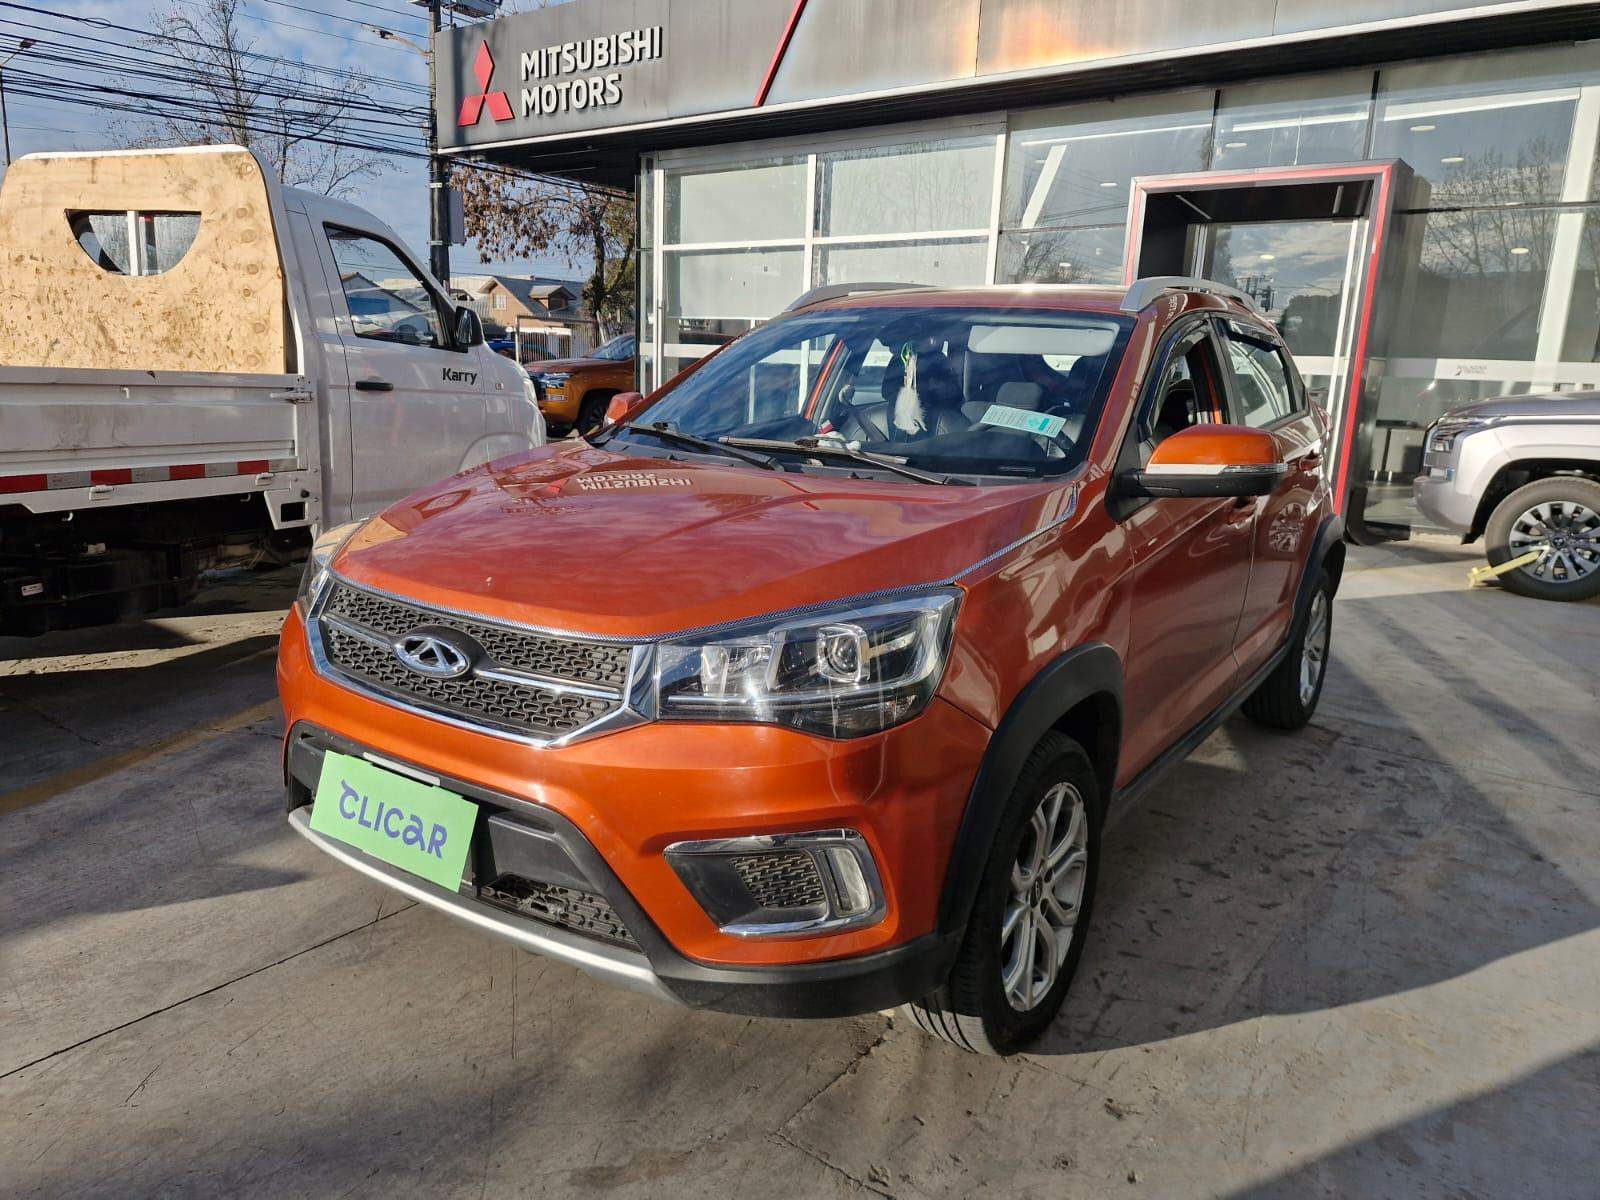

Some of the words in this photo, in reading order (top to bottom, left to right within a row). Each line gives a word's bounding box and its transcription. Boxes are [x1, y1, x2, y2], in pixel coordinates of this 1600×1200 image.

[521, 26, 663, 81] MITSUBISHI
[521, 73, 622, 117] MOTORS
[442, 367, 478, 385] Karry
